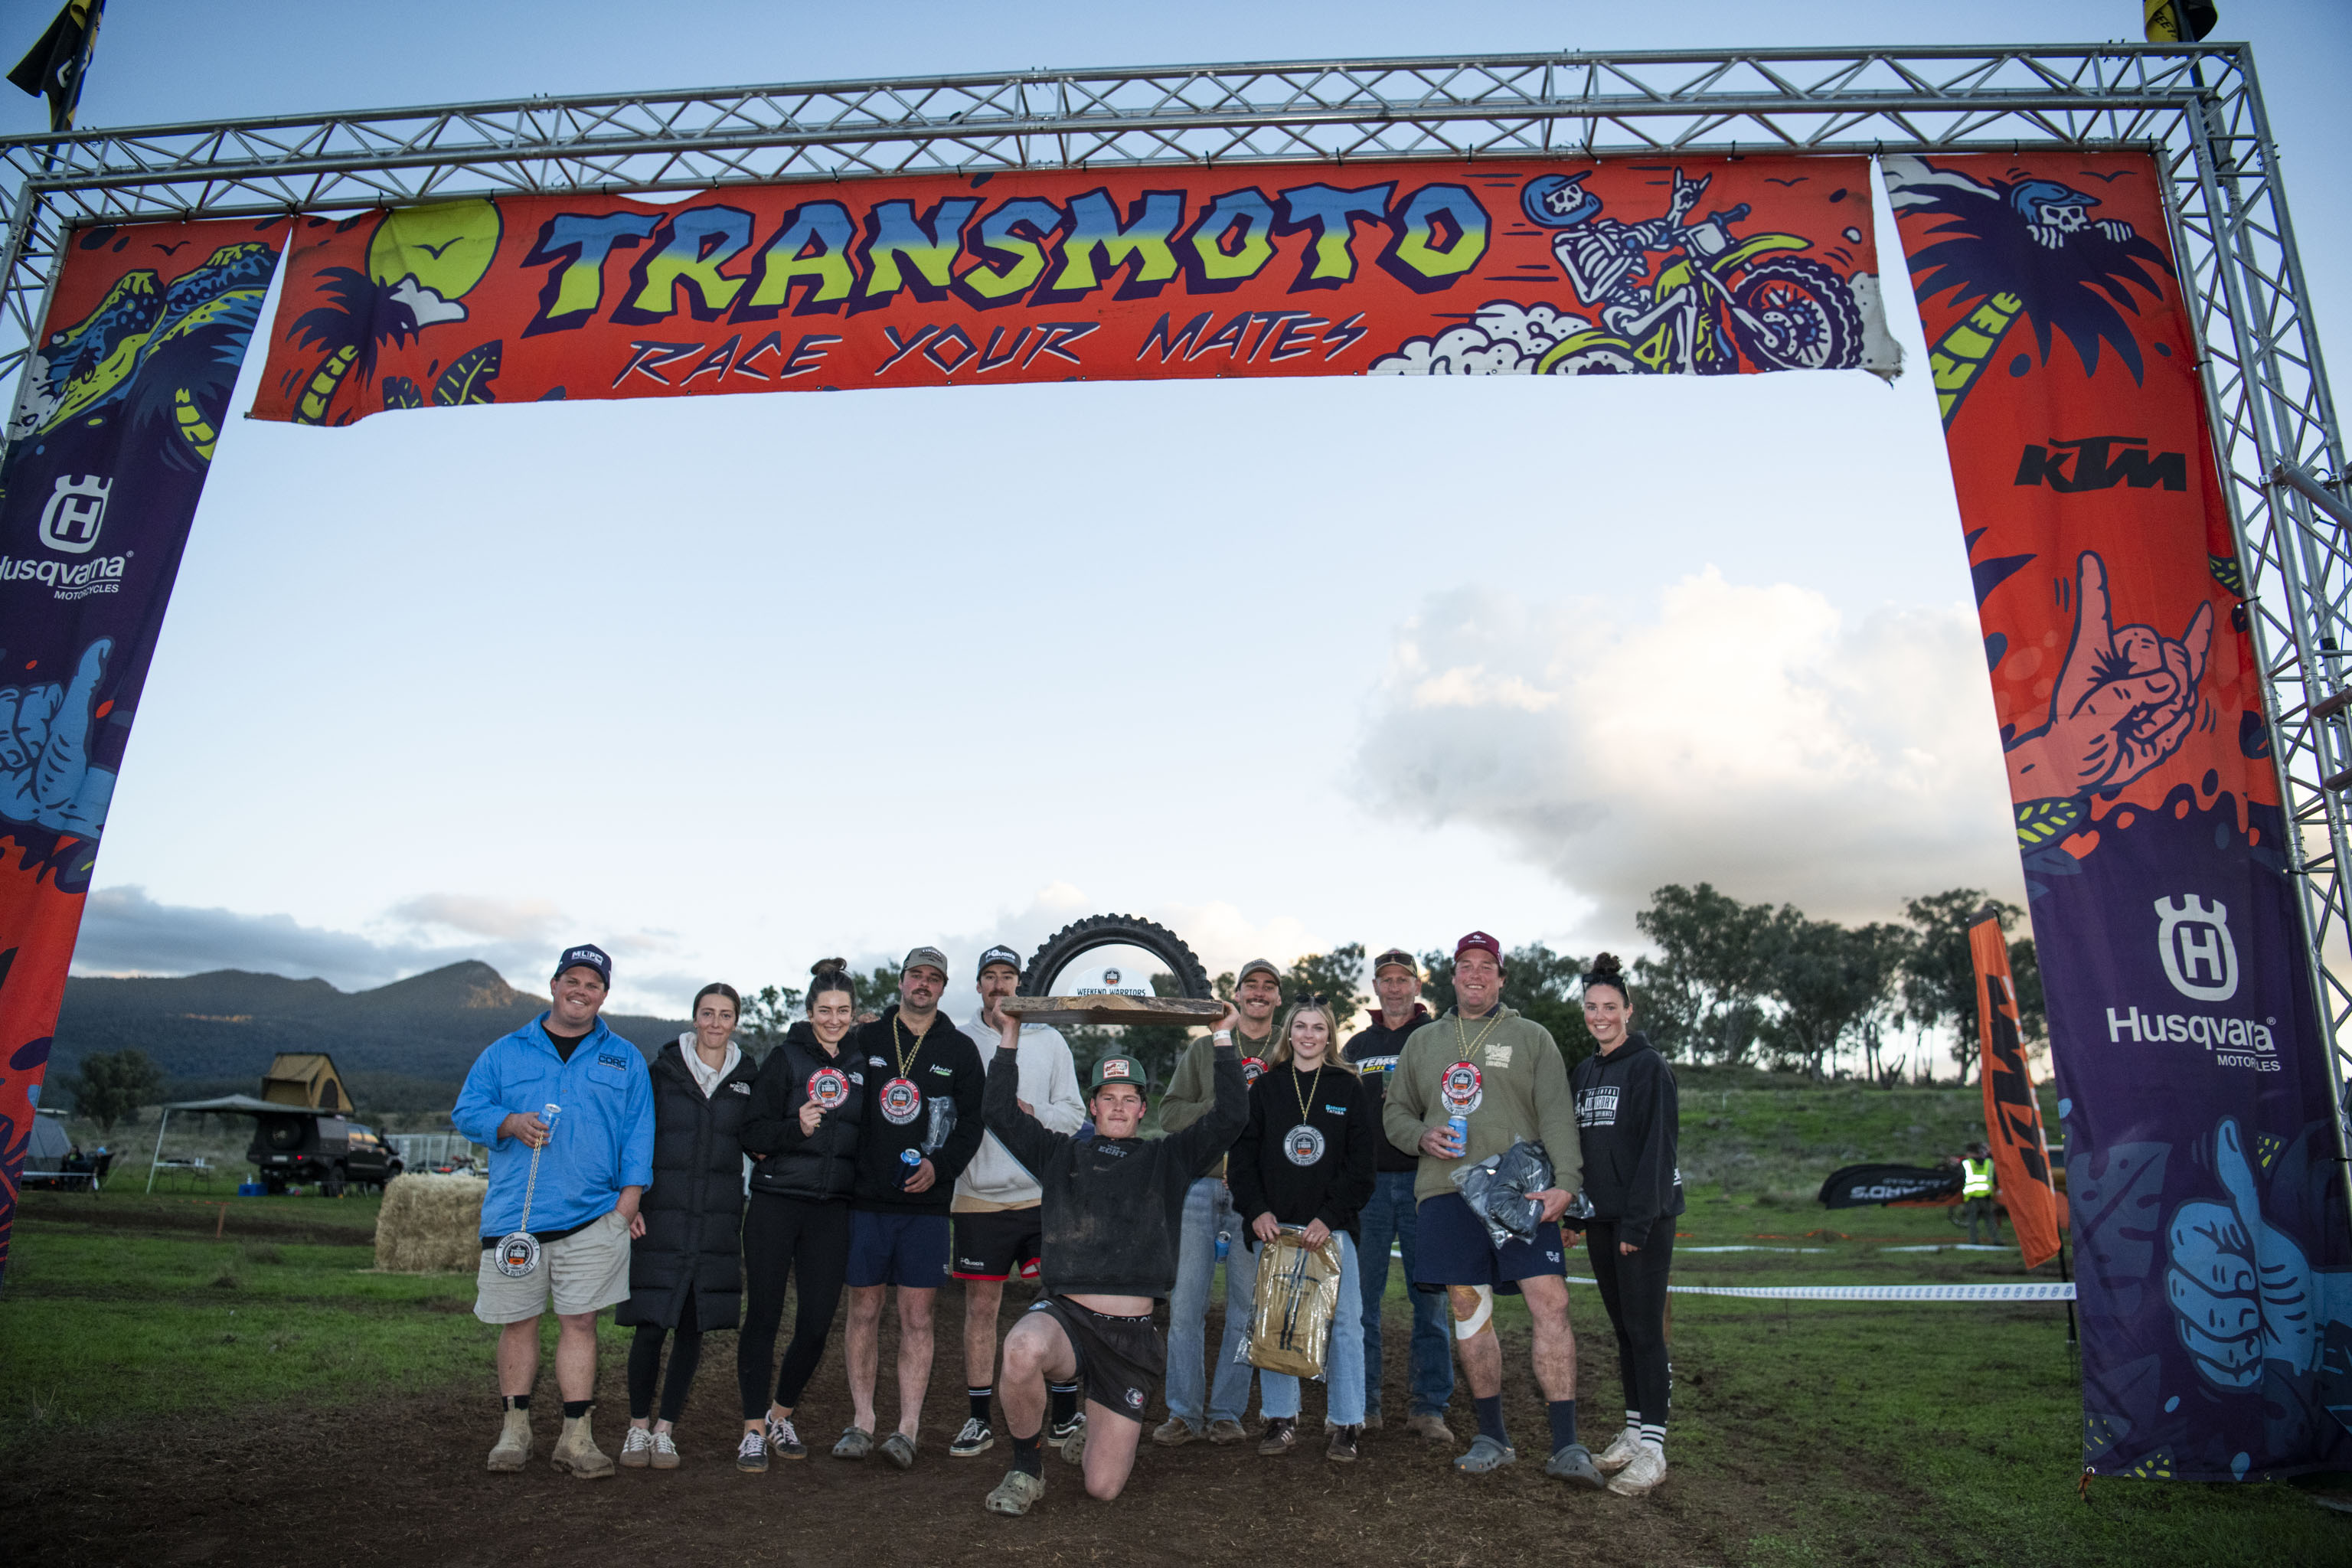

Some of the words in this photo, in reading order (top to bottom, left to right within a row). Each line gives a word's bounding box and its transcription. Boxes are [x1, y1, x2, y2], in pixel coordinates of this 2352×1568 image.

[521, 181, 1492, 338] TRANSMOTO
[612, 333, 843, 388] RACE
[874, 322, 1100, 375] YOUR
[1136, 311, 1368, 363] MATES
[2014, 436, 2187, 494] KTM
[54, 584, 119, 601] MOTORCYCLES
[1109, 988, 1146, 997] WARRIORS
[1986, 973, 2050, 1188] KTM
[1098, 1145, 1127, 1158] ECHT
